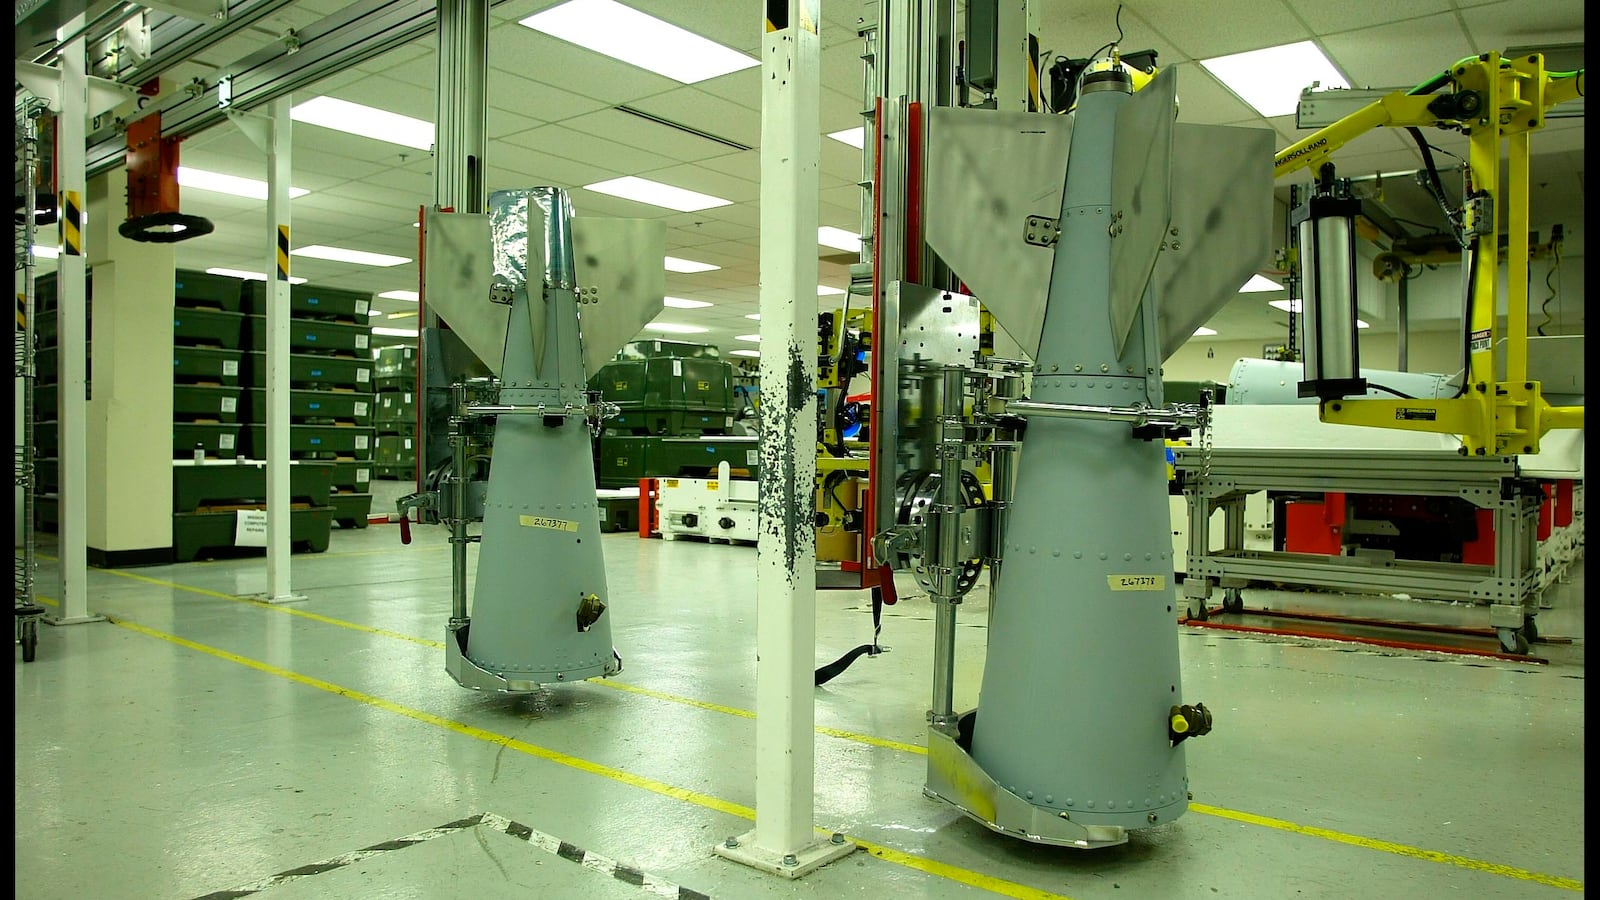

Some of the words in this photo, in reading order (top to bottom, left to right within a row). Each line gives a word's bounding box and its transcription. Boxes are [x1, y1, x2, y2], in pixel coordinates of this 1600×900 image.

[1275, 138, 1326, 166] NGERSOLL-RAND
[534, 518, 568, 531] 267377
[1120, 577, 1155, 586] 267378
